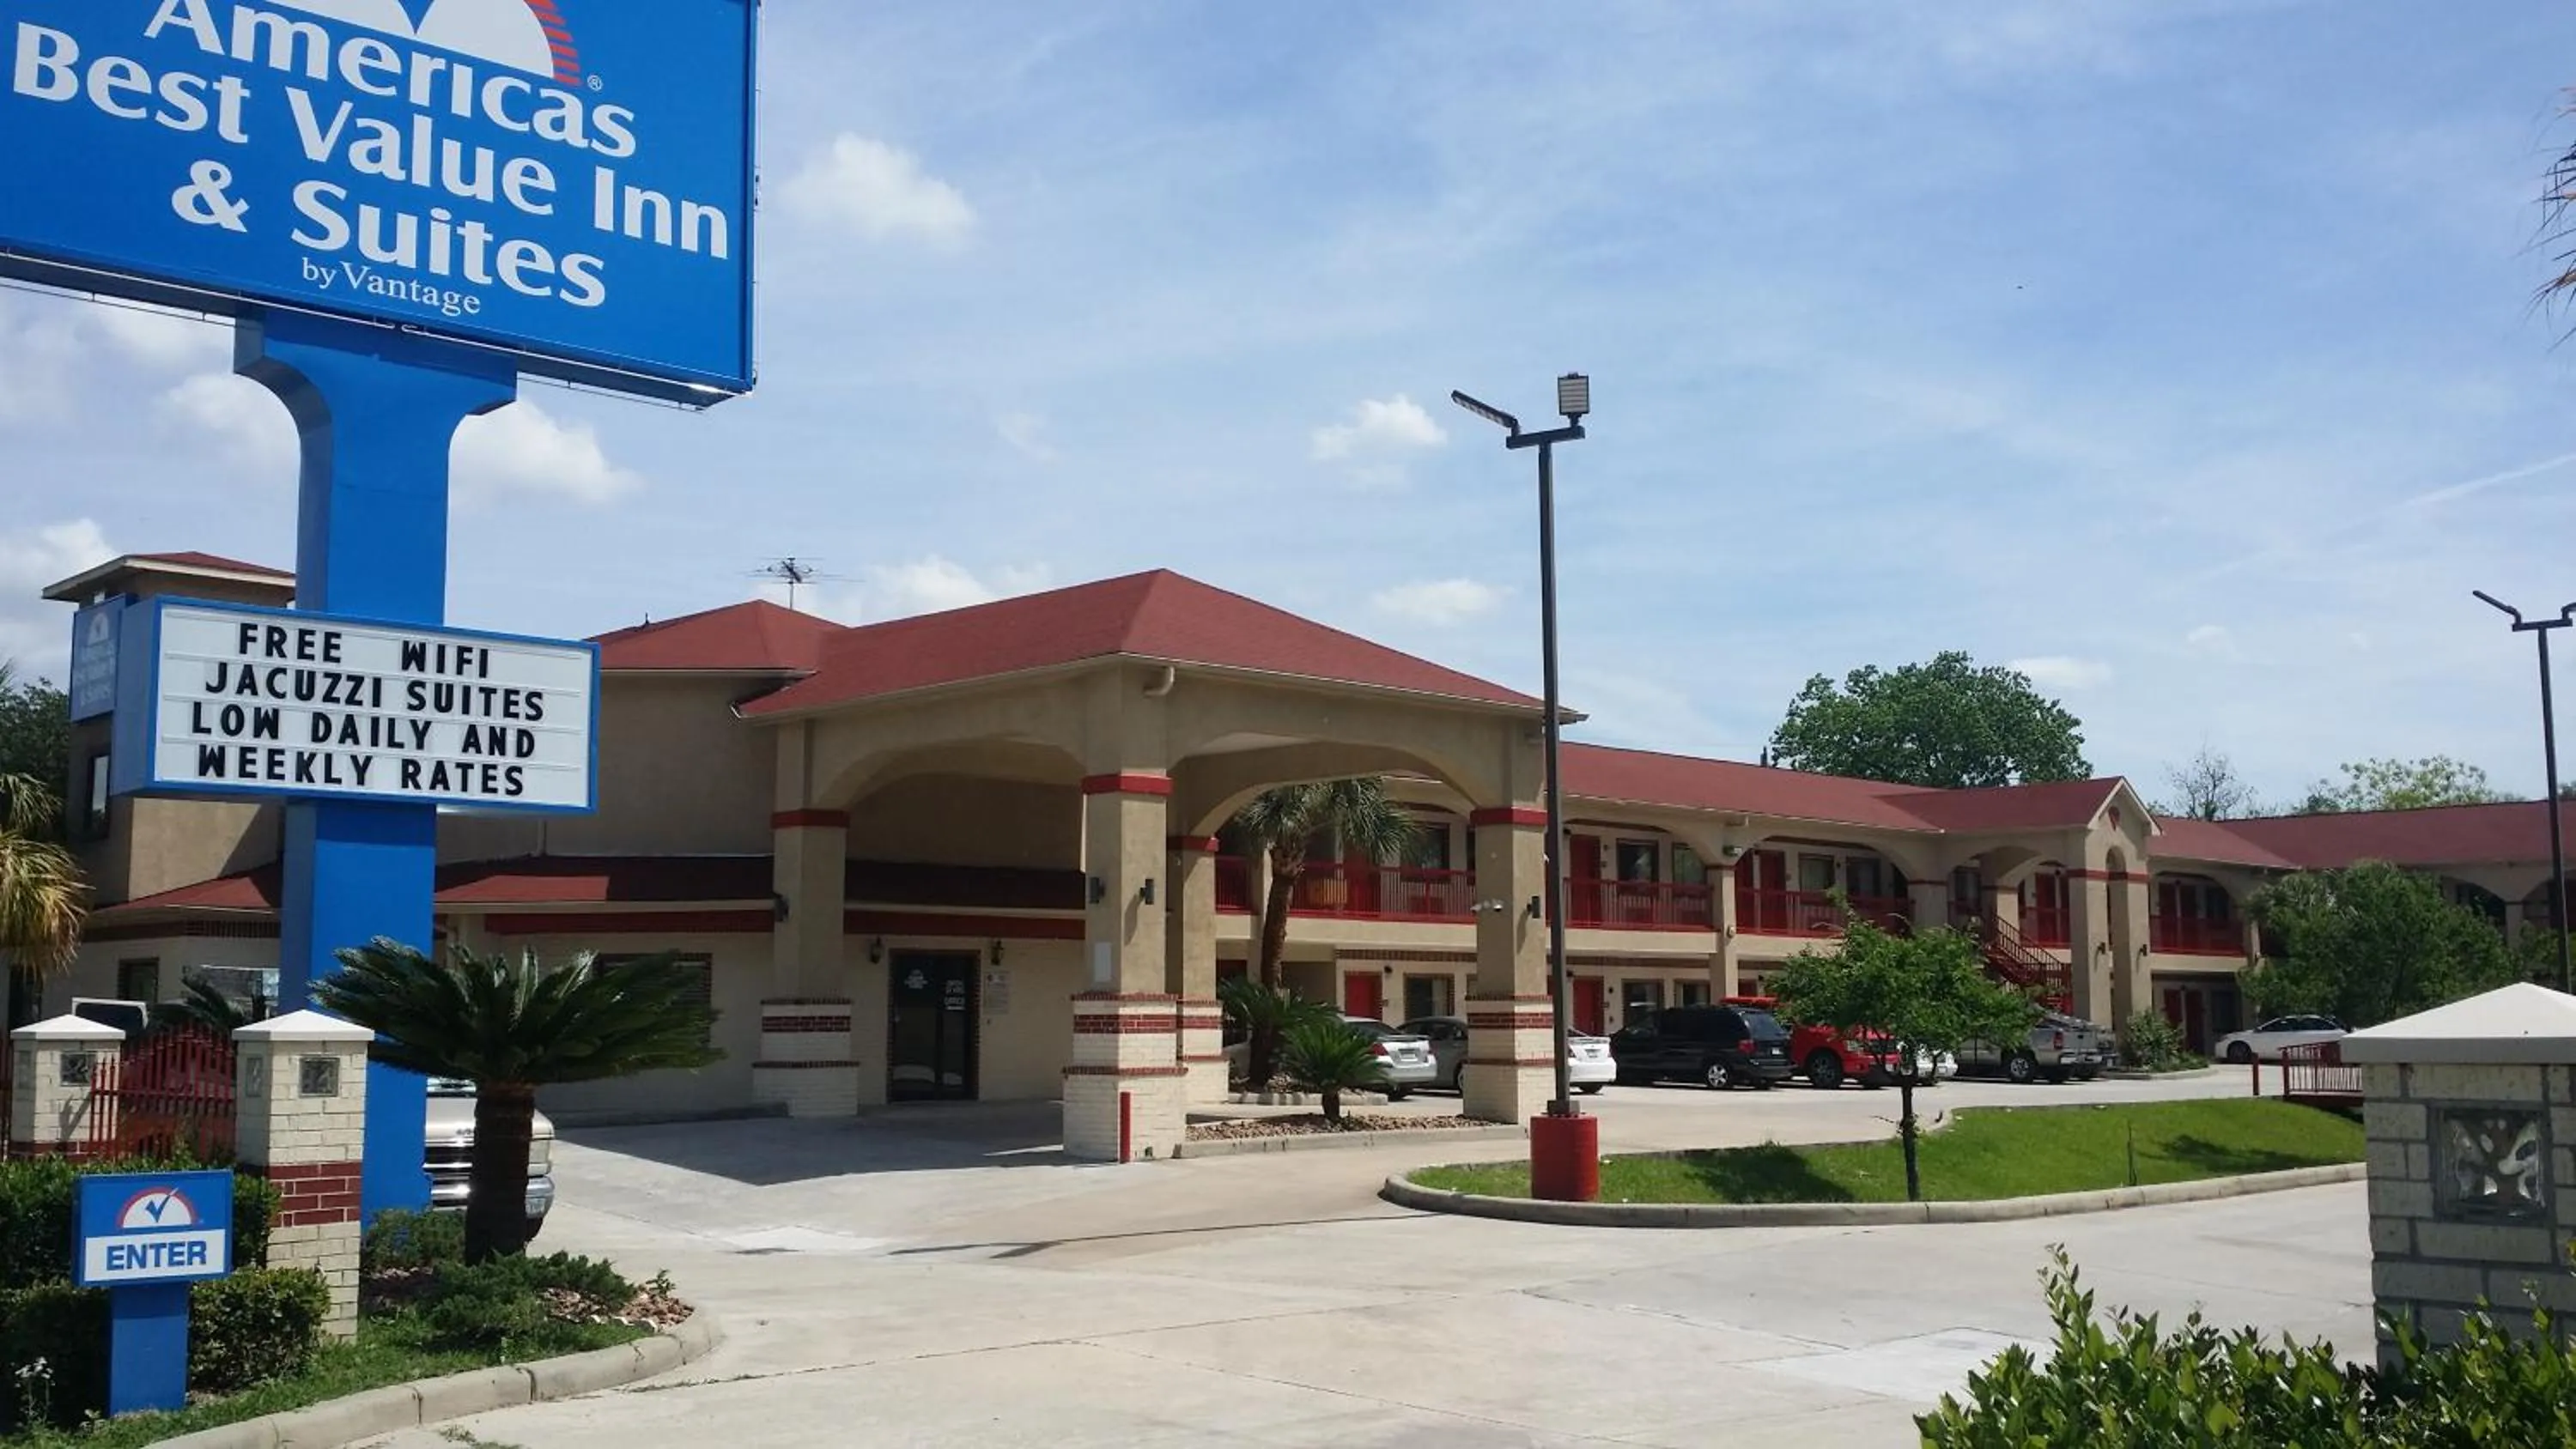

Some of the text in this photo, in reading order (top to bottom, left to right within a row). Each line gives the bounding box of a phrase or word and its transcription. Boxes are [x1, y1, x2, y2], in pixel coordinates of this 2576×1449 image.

[143, 0, 636, 158] Americas
[13, 21, 728, 259] Best Value Inn
[172, 160, 606, 307] & Suites
[302, 257, 481, 317] by Vantage
[239, 622, 489, 679] FREE WIFI
[205, 661, 544, 722] JACUZZI SUITES
[191, 700, 535, 759] LOW DAILY AND
[198, 743, 523, 797] WEEKLY RATES
[106, 1240, 207, 1271] ENTER
